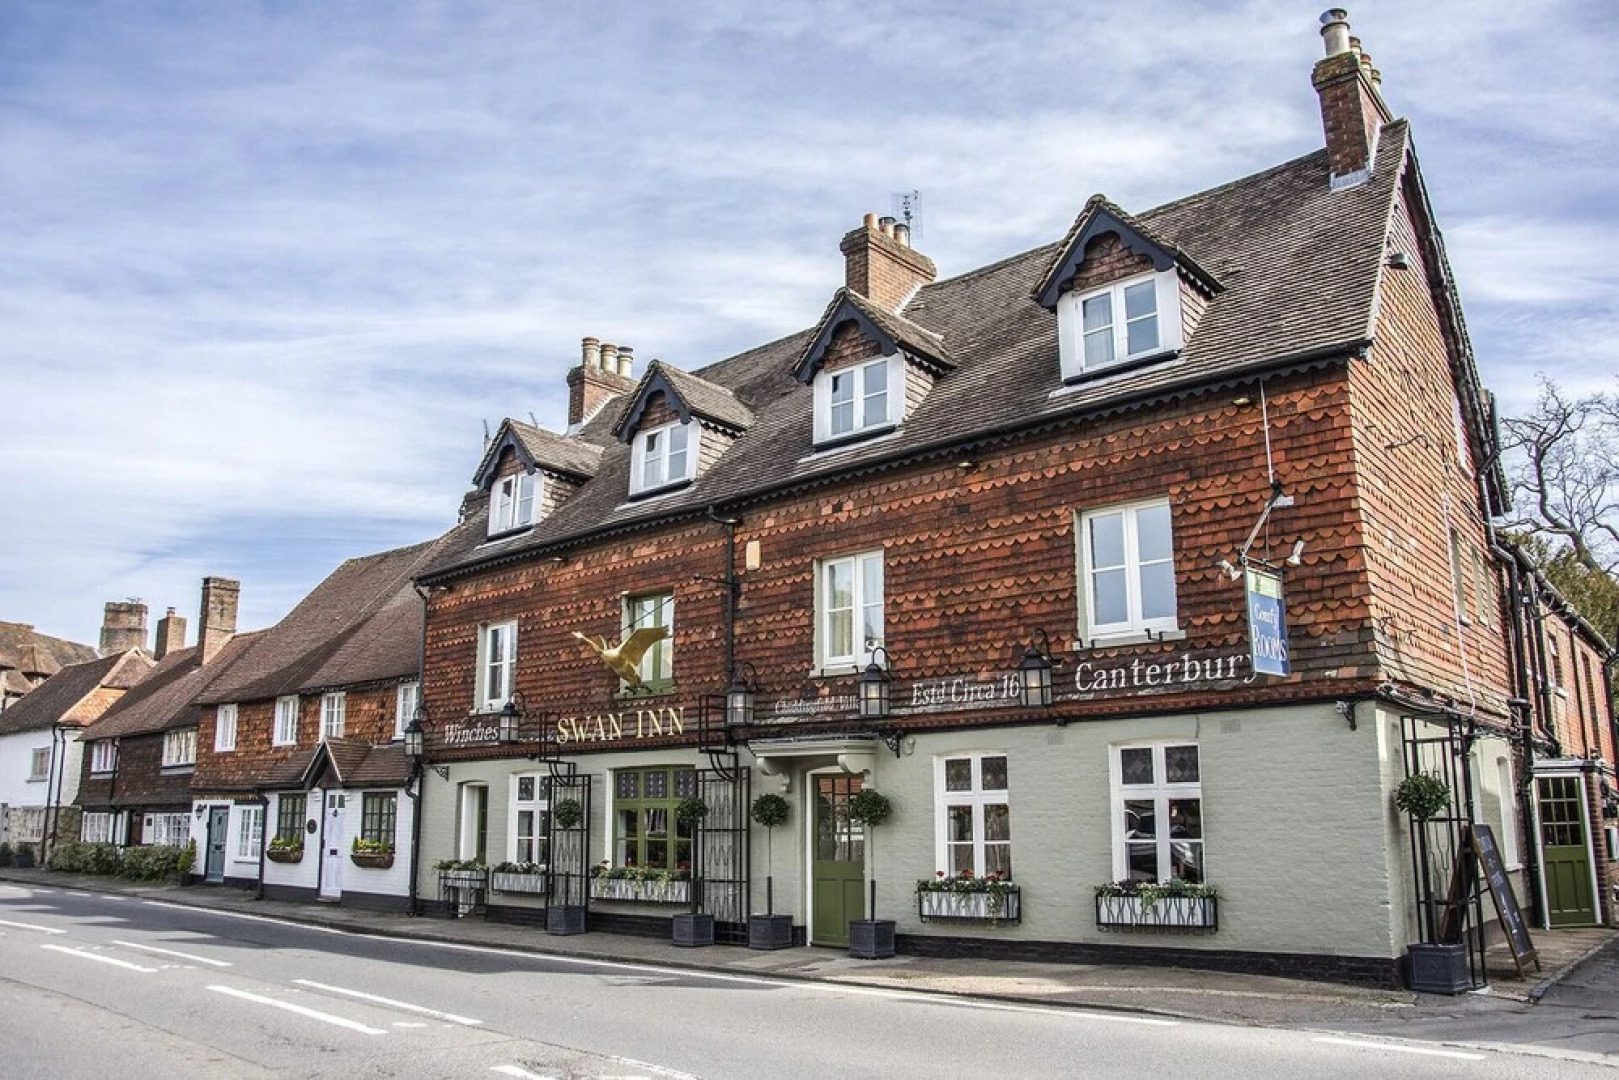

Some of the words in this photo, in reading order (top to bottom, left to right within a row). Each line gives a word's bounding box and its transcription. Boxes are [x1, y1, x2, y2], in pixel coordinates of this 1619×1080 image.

[952, 678, 995, 702] Circa
[1001, 673, 1019, 699] 16
[444, 721, 499, 744] Winches
[556, 713, 624, 744] SWAN
[636, 706, 684, 739] INN
